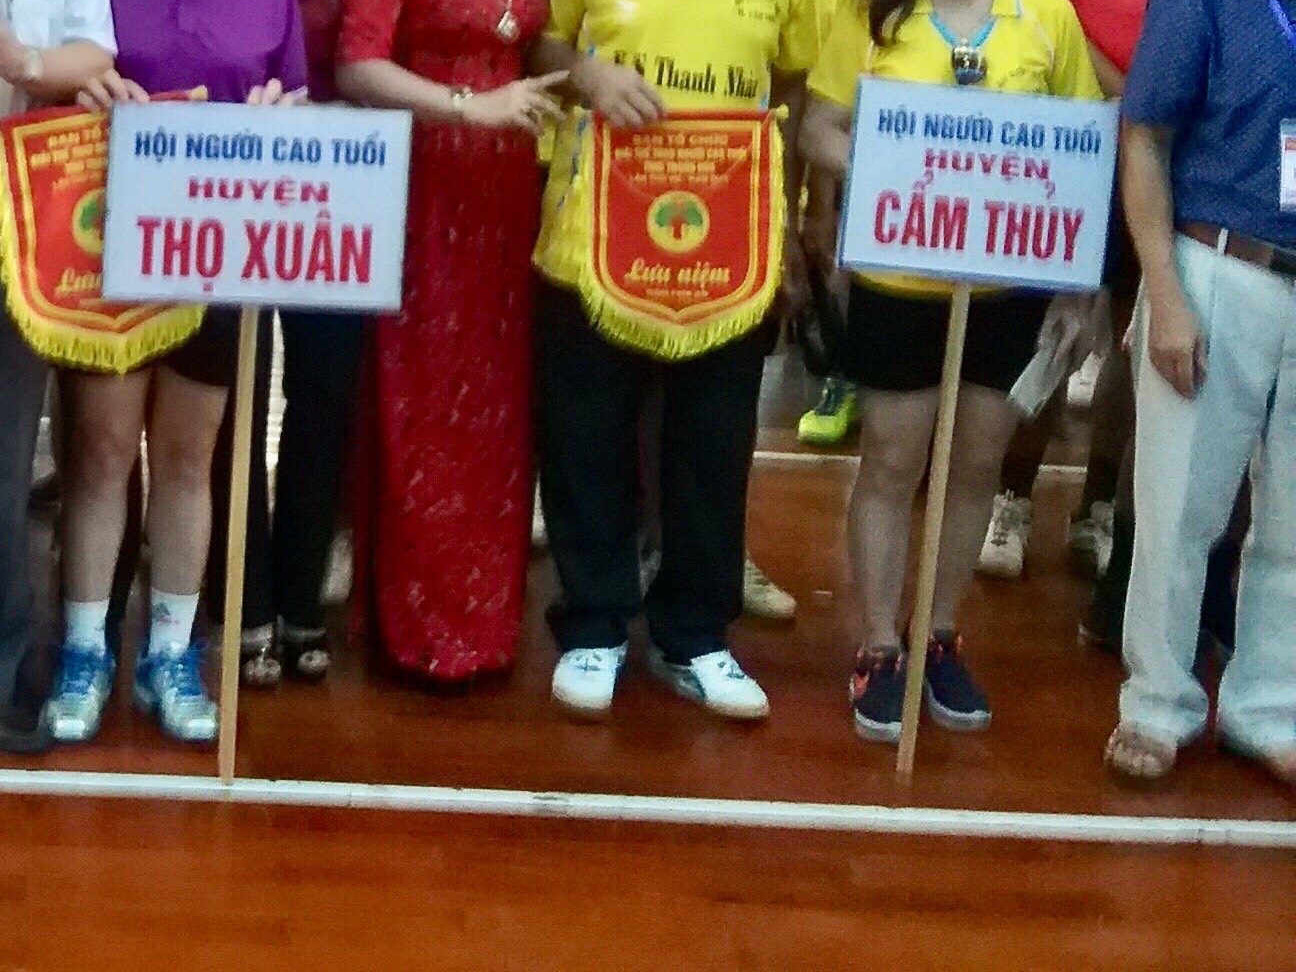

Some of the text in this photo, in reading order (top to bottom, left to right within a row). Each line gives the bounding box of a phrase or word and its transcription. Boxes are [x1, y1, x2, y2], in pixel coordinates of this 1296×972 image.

[134, 126, 176, 160] HỘI
[186, 128, 264, 163] NGƯỜI
[272, 134, 322, 165] CAO
[332, 129, 387, 168] TUỔI
[877, 104, 917, 140] HỘI
[923, 111, 994, 144] NGƯỜI
[1000, 121, 1046, 151] CAO
[924, 147, 1052, 182] HUYỆN
[187, 176, 331, 207] HUYỆN
[137, 208, 373, 294] THỌ XUÂN
